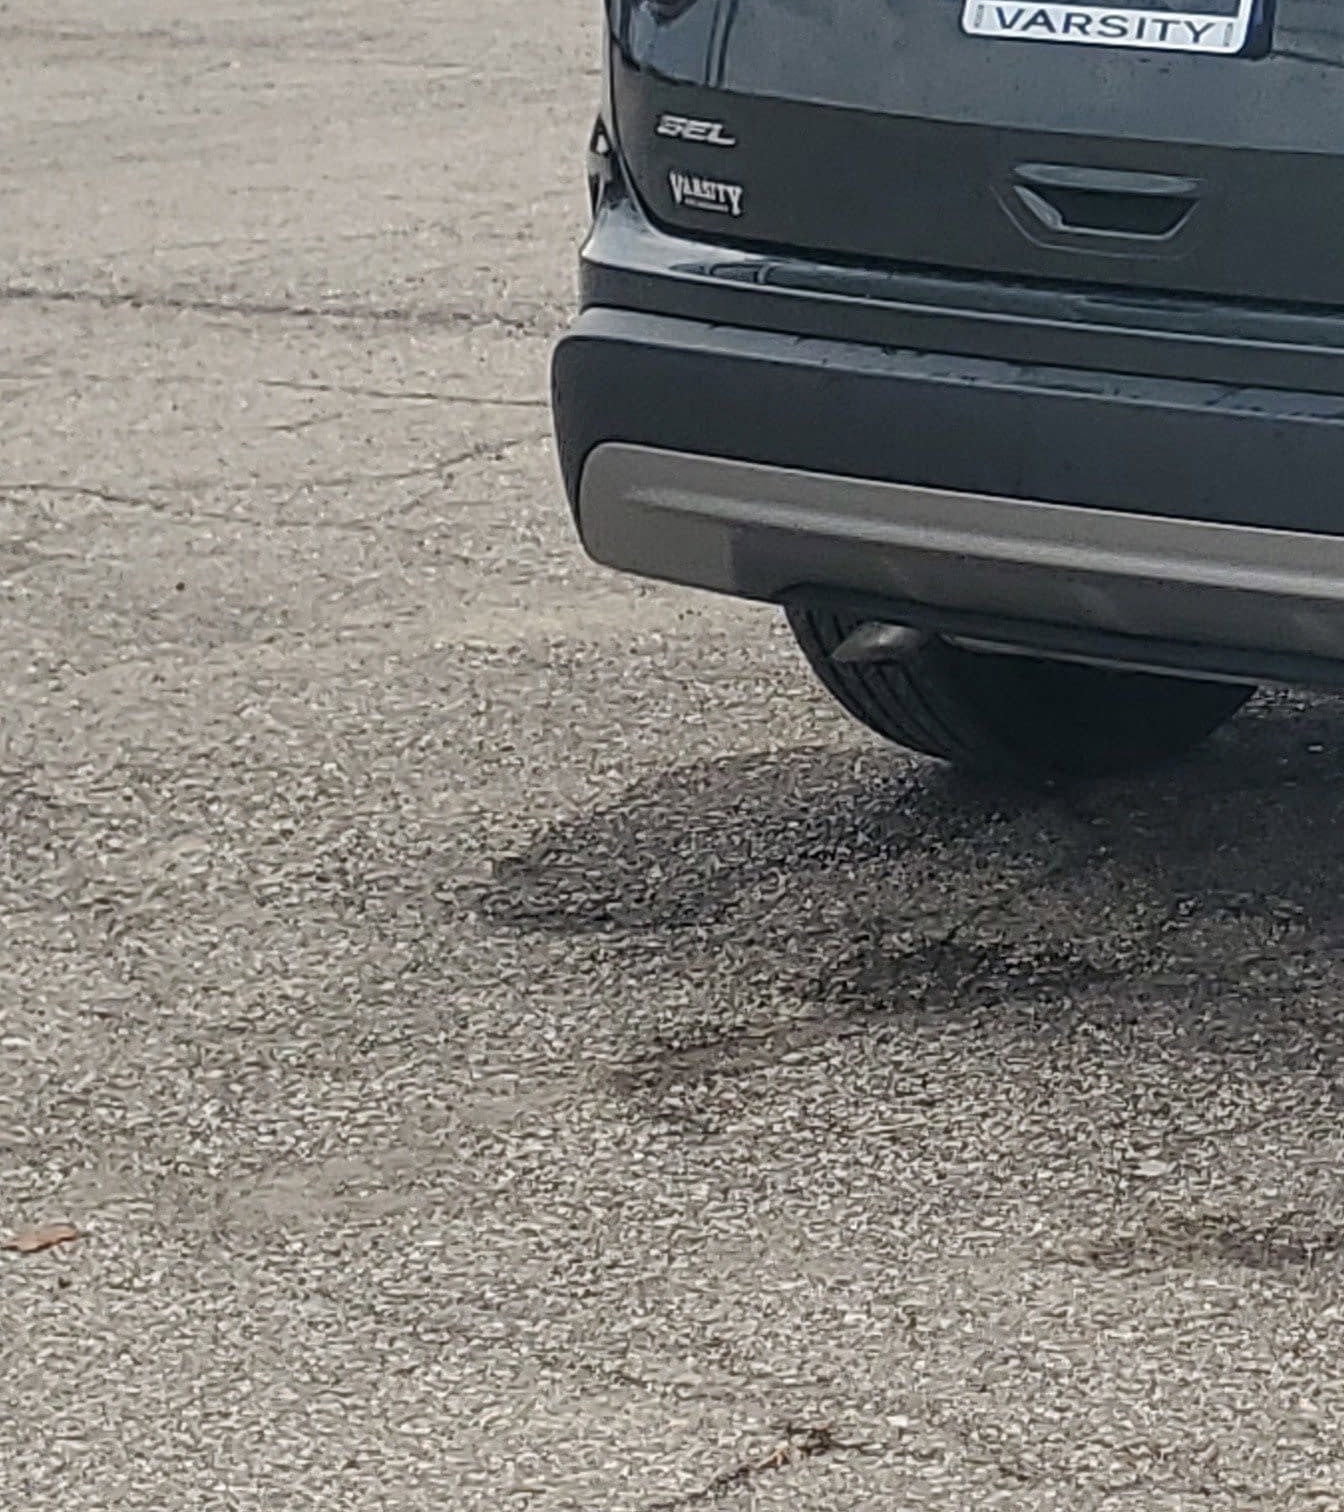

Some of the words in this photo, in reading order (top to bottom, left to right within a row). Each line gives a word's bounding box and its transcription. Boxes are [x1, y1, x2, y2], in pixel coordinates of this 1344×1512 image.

[995, 6, 1216, 44] VARSITY
[657, 114, 737, 146] SEL
[669, 171, 743, 216] VARSITY
